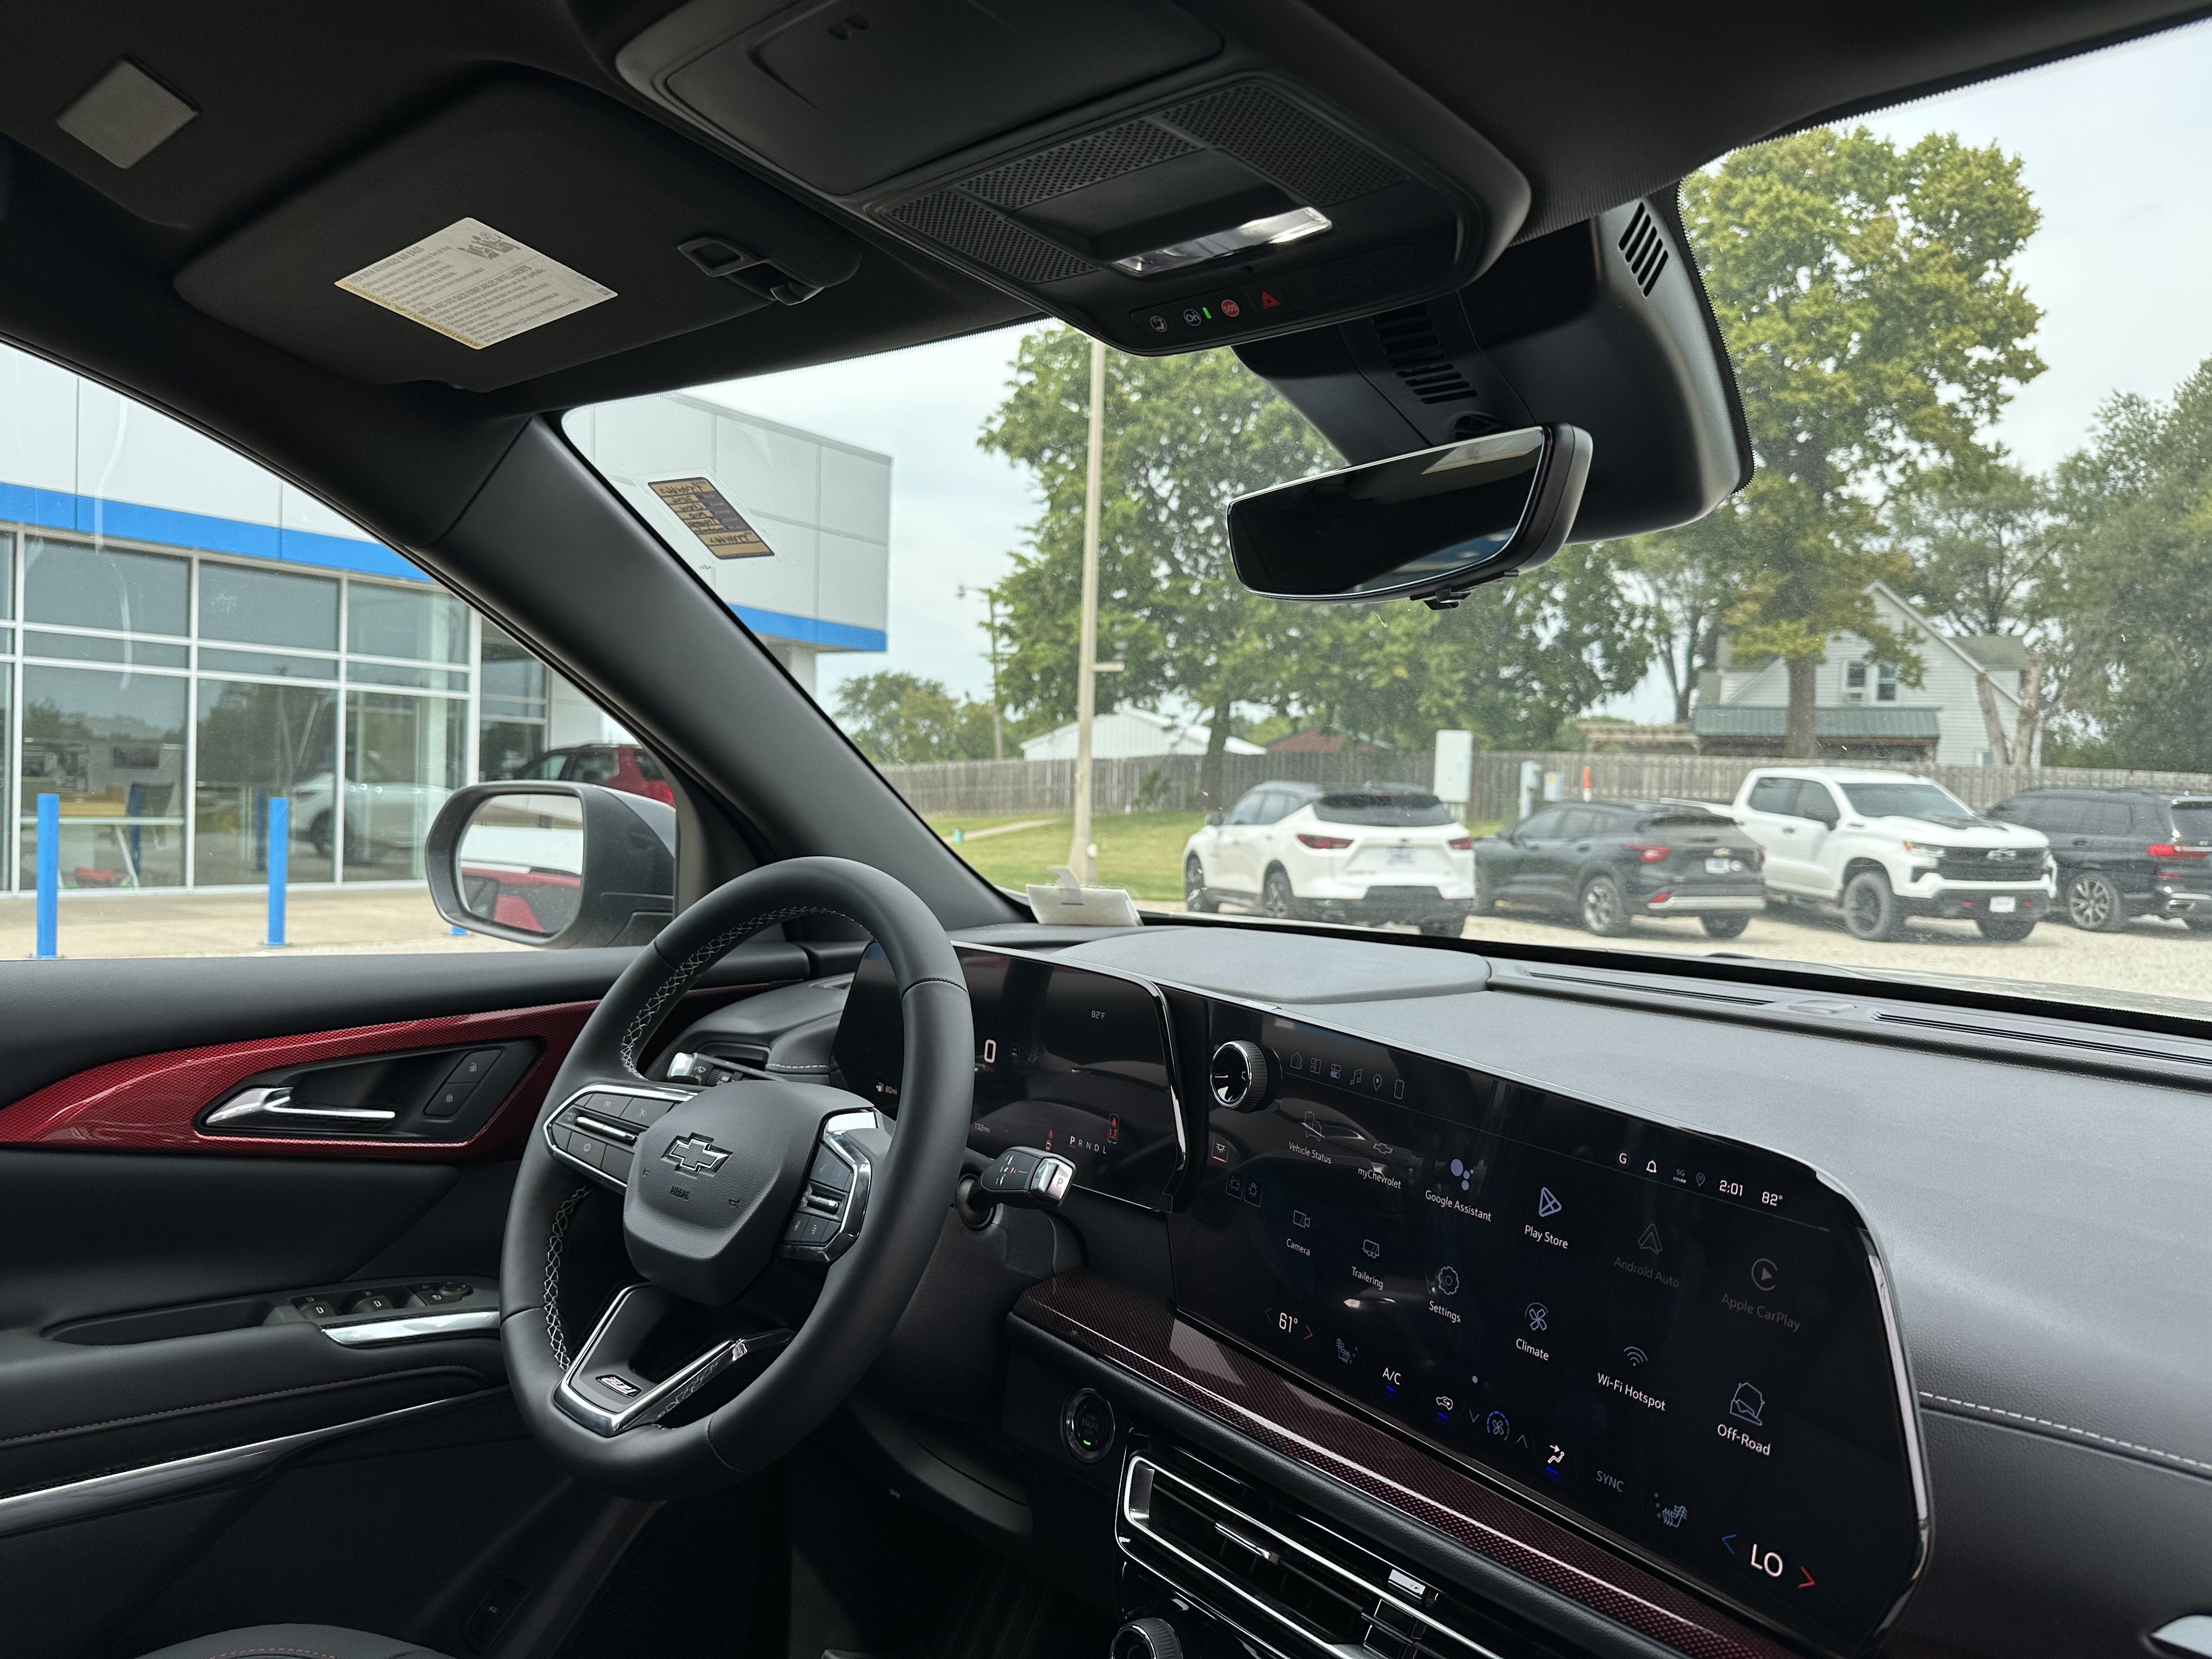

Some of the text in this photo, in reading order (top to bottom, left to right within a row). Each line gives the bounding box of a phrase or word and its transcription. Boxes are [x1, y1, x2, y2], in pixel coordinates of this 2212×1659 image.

[398, 252, 411, 261] AIR
[406, 246, 425, 256] BAGS
[343, 283, 392, 306] WARNING
[1223, 303, 1238, 313] SOS
[984, 1039, 996, 1063] 0
[974, 1122, 990, 1133] 132mi
[1070, 1136, 1107, 1154] P R N D L
[1289, 1141, 1332, 1164] Vehicle Status
[1619, 1152, 1628, 1165] G
[1357, 1167, 1402, 1190] myChevrolet
[1676, 1169, 1686, 1177] 5G
[669, 1186, 691, 1201] AIRBAG
[1719, 1180, 1743, 1197] 2:01
[1761, 1191, 1783, 1206] 82°
[1425, 1189, 1492, 1223] Google Assistant
[1286, 1238, 1311, 1257] Camera
[1525, 1224, 1569, 1249] Play Store
[1351, 1266, 1384, 1291] Trailering
[1613, 1256, 1680, 1288] Android Auto
[1279, 1312, 1299, 1333] 61°
[1428, 1300, 1462, 1323] Settings
[1720, 1293, 1801, 1333] Apple CarPlay
[1515, 1338, 1550, 1361] Climate
[1382, 1367, 1402, 1386] A/C
[1597, 1372, 1667, 1412] Wi-Fi Hotspot
[1717, 1423, 1772, 1457] Off-Road
[1596, 1470, 1625, 1493] SYNC
[1750, 1543, 1784, 1578] LO
